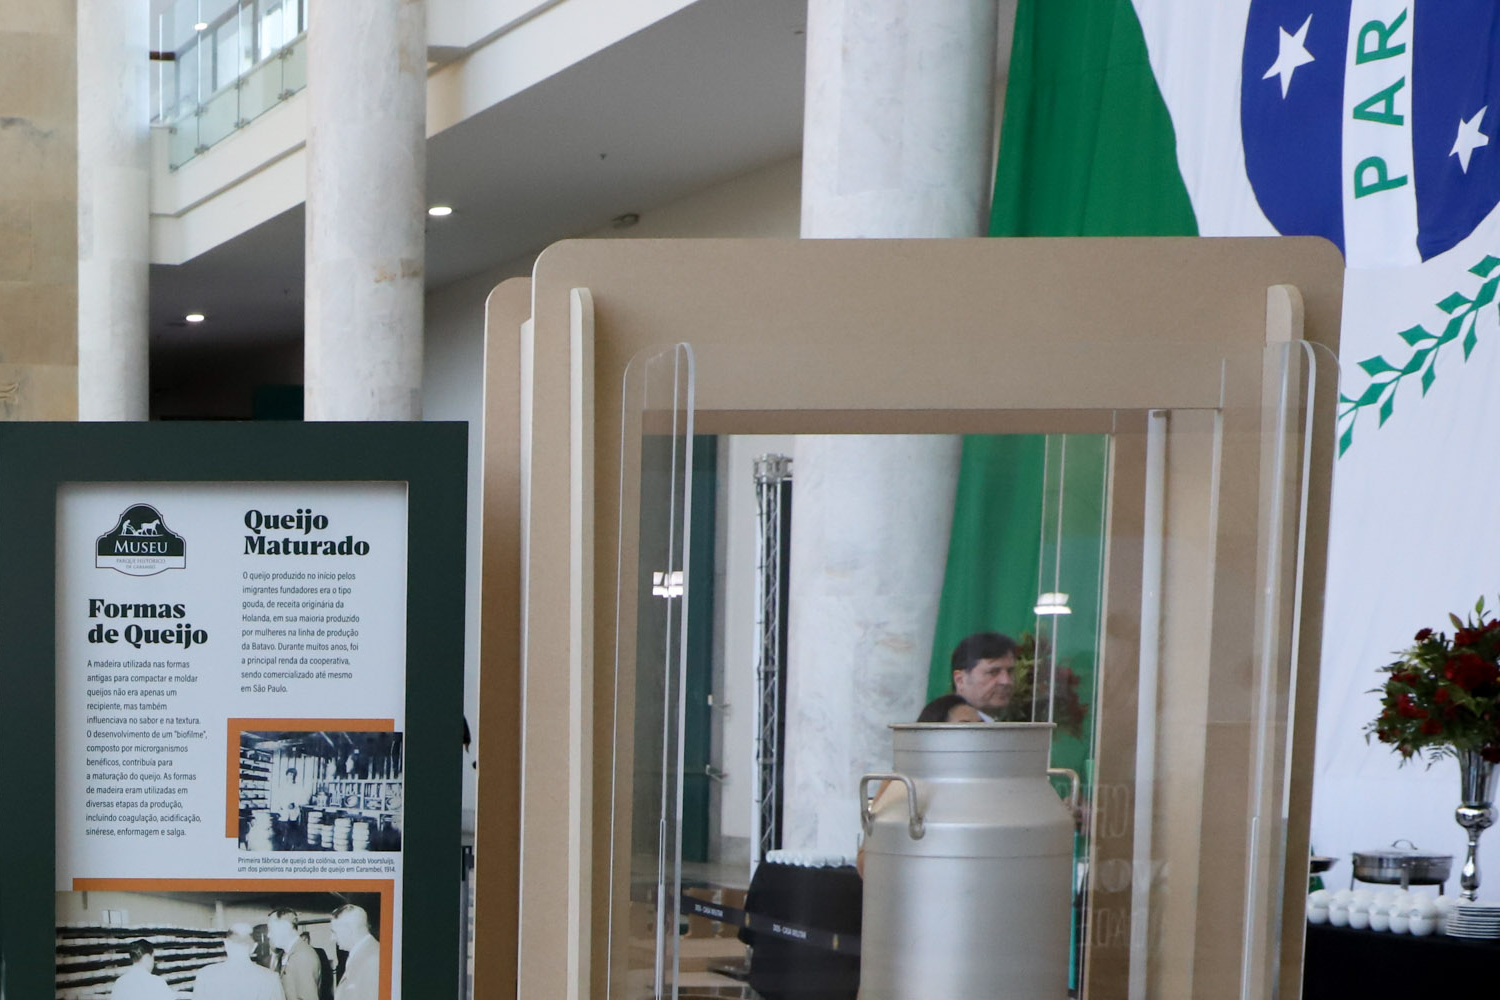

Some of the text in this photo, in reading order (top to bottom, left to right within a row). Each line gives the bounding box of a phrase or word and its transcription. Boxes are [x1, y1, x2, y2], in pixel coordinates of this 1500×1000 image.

[244, 509, 328, 535] Queijo
[245, 536, 369, 555] Maturado
[242, 571, 248, 579] O
[249, 573, 271, 581] queijo
[272, 571, 306, 581] produzido
[317, 572, 336, 580] início
[337, 572, 356, 581] pelos
[242, 586, 278, 596] imigrantes
[280, 586, 318, 594] fundadores
[338, 587, 352, 596] tipo
[89, 599, 186, 618] Formas
[242, 600, 344, 610] gouda, de receita originária da
[242, 614, 271, 622] Holanda,
[326, 614, 360, 624] produzido
[88, 623, 208, 649] de Queijo
[254, 628, 287, 636] mulheres
[298, 628, 315, 636] linha
[316, 628, 325, 636] de
[326, 628, 359, 638] produção
[241, 642, 250, 650] da
[251, 642, 276, 650] Batavo.
[277, 642, 304, 650] Durante
[330, 644, 349, 652] anos,
[350, 642, 359, 651] foi
[93, 660, 122, 668] madeira
[122, 660, 152, 668] utilizada
[166, 660, 190, 668] formas
[247, 656, 277, 666] principal
[278, 656, 298, 664] renda
[299, 656, 308, 664] da
[309, 657, 350, 666] cooperativa,
[87, 674, 112, 684] antigas
[113, 675, 129, 683] para
[130, 675, 167, 683] compactar
[174, 674, 198, 682] moldar
[241, 670, 262, 678] sendo
[263, 670, 314, 679] comercializado
[315, 671, 326, 679] até
[86, 689, 112, 697] queijos
[113, 688, 126, 696] não
[253, 684, 266, 692] São
[267, 684, 287, 693] Paulo.
[86, 703, 122, 711] recipiente,
[139, 702, 168, 710] também
[86, 716, 128, 724] influenciava
[139, 716, 158, 724] sabor
[86, 730, 92, 738] O
[93, 730, 150, 738] desenvolvimento
[151, 730, 160, 738] de
[174, 730, 207, 739] "biofilme",
[86, 745, 120, 753] composto
[134, 744, 188, 754] microrganismos
[86, 758, 173, 768] benéficos, contribuía para
[92, 772, 128, 782] maturação
[129, 772, 138, 780] do
[139, 774, 161, 782] queijo.
[163, 772, 172, 780] As
[173, 772, 196, 780] formas
[86, 786, 95, 794] de
[96, 786, 124, 794] madeira
[144, 786, 176, 794] utilizadas
[86, 800, 183, 810] diversas etapas da produção,
[85, 814, 202, 824] incluindo coagulação, acidificação,
[86, 828, 116, 836] sinérese,
[117, 828, 160, 838] enformagem
[166, 828, 186, 838] salga.
